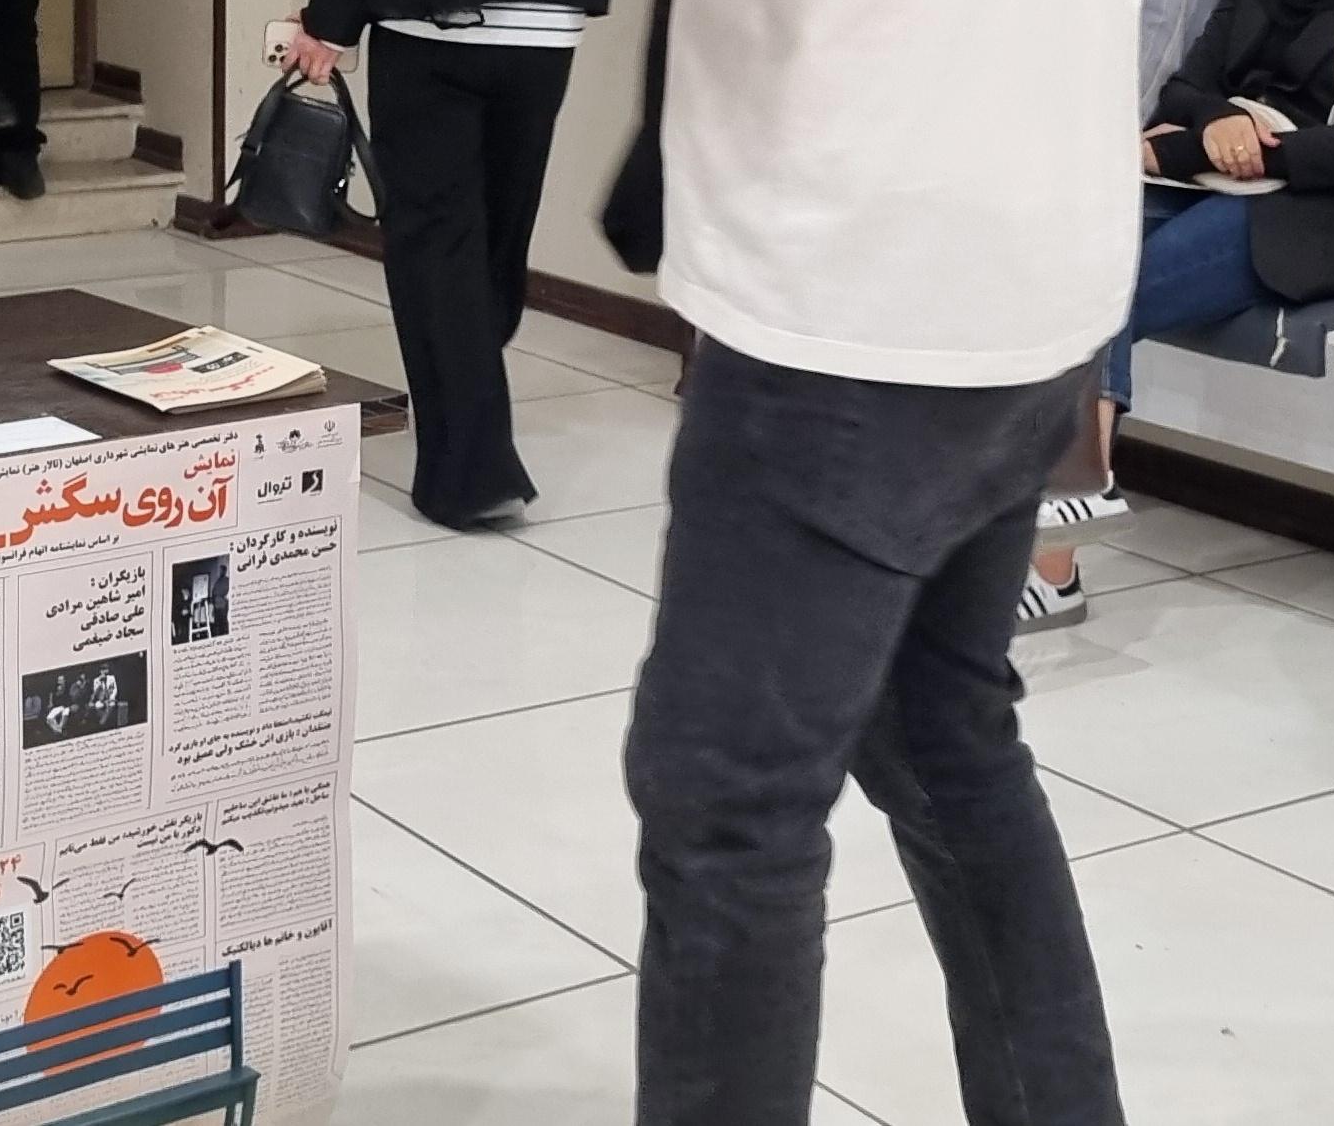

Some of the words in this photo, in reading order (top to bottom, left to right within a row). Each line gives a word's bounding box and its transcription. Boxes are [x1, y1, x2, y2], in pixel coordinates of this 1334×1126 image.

[64, 453, 93, 470] اصفهان
[94, 447, 130, 467] شهرداری
[183, 448, 237, 480] نمایش
[257, 475, 292, 499] تروال
[122, 485, 184, 530] روی
[187, 475, 235, 523] آن
[290, 531, 296, 544] و
[298, 518, 339, 538] نویسنده
[236, 528, 287, 554] کارگردان
[310, 541, 338, 558] حسن
[236, 553, 268, 573] فرانی
[269, 548, 310, 567] محمدی
[86, 589, 122, 611] شاهین
[125, 584, 146, 605] امیر
[45, 599, 83, 619] مرادی
[122, 604, 145, 623] علی
[80, 610, 120, 631] صادقی
[115, 625, 145, 641] سجاد
[234, 738, 258, 752] خشک
[275, 729, 295, 745] بازی
[176, 753, 191, 767] بود
[215, 742, 233, 758] ولی
